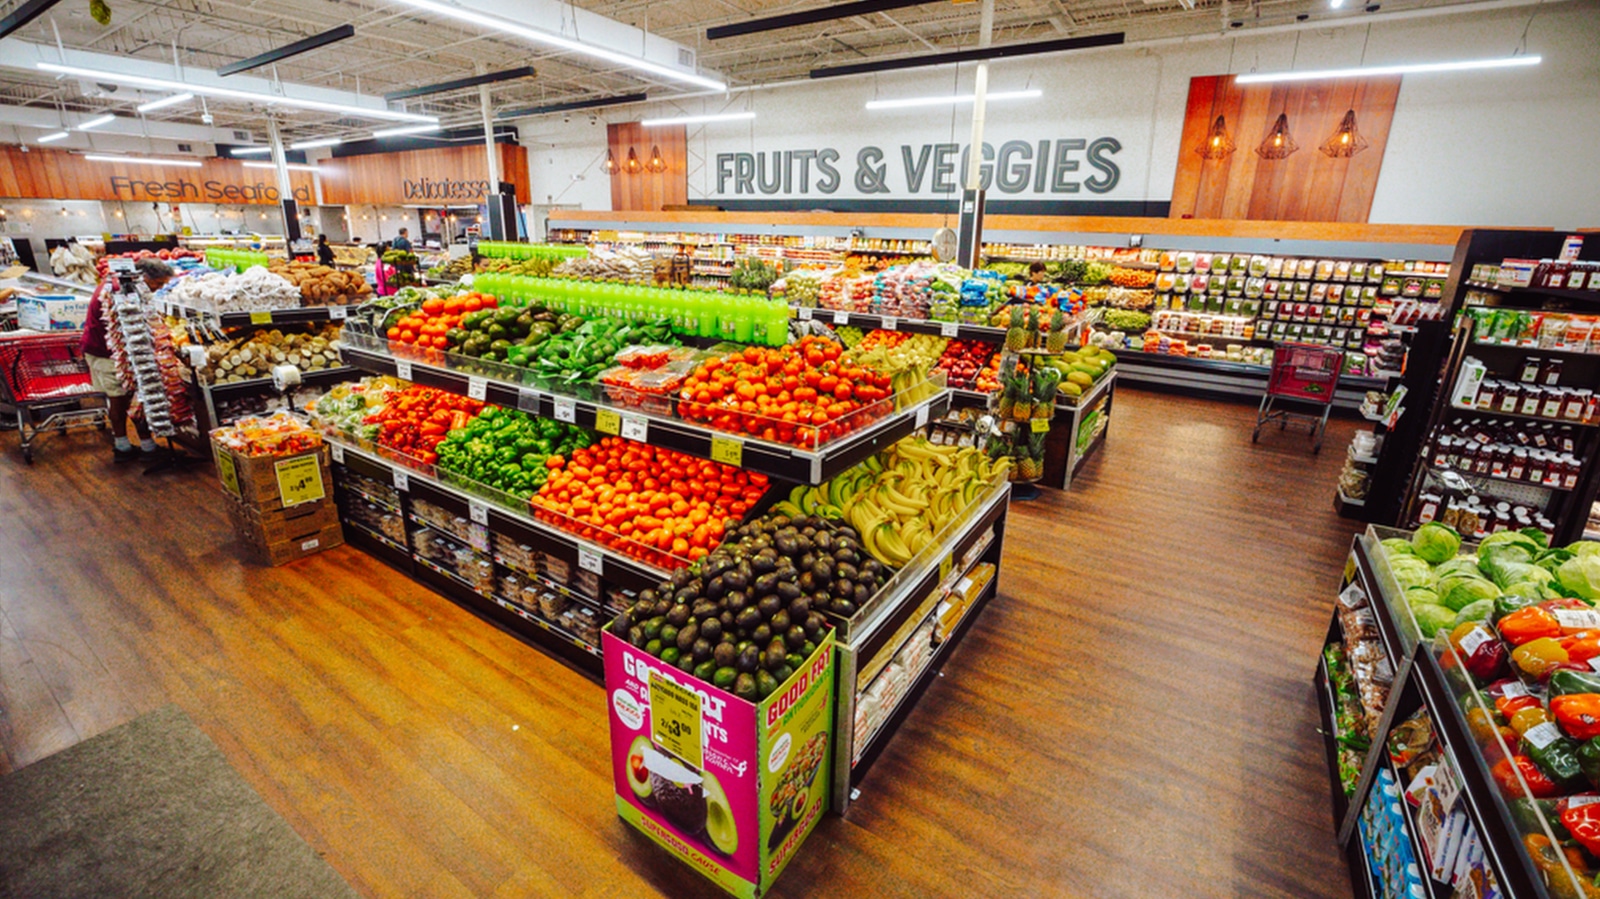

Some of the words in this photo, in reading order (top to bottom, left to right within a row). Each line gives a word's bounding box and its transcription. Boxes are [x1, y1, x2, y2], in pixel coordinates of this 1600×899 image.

[110, 176, 199, 198] Fresh
[204, 180, 310, 201] Seafod
[403, 178, 491, 199] Delicatesse
[716, 148, 841, 194] FRUITS
[854, 146, 890, 194] &
[901, 137, 1122, 194] VEGGIES
[767, 672, 808, 728] GOOD
[810, 644, 832, 685] FAT
[641, 816, 689, 856] SUPERGOOD
[691, 853, 720, 875] CAUSE
[769, 797, 822, 877] SUPERGOOD
